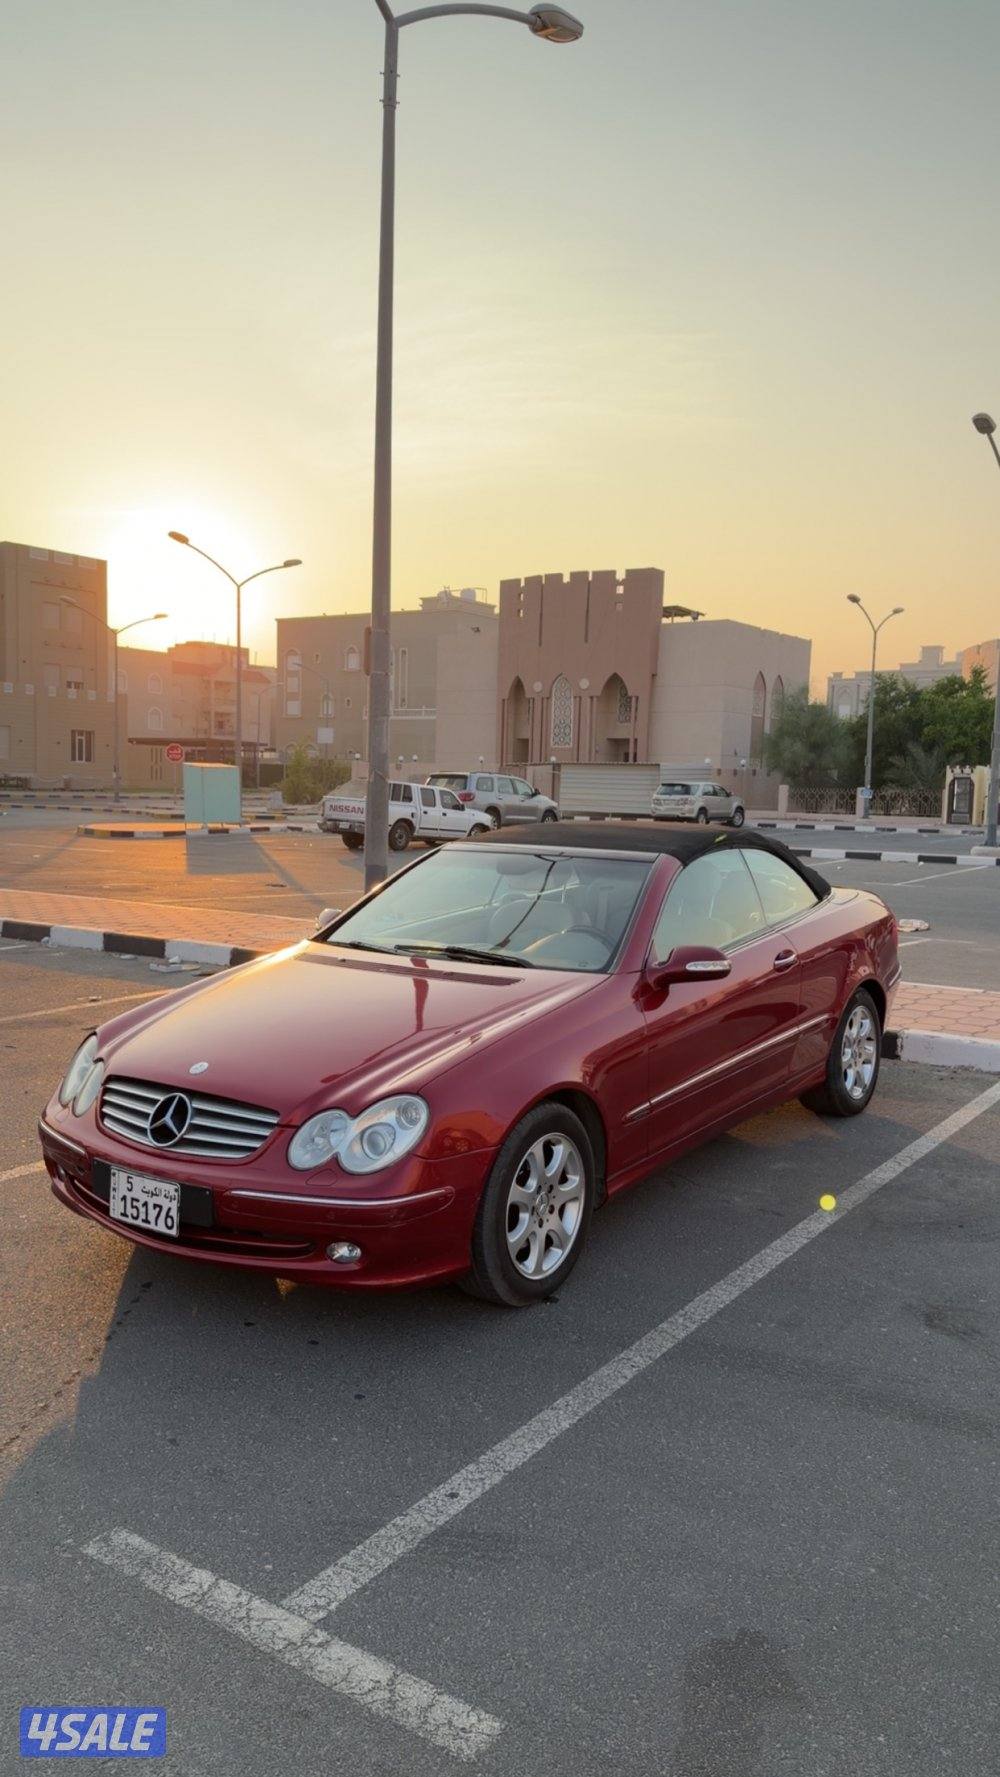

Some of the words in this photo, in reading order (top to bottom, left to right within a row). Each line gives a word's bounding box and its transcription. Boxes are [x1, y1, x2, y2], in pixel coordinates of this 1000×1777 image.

[329, 804, 364, 815] NISSAN
[126, 1175, 134, 1192] 5
[141, 1186, 162, 1198] الكويت
[163, 1188, 177, 1202] دولة
[120, 1194, 175, 1231] 15176
